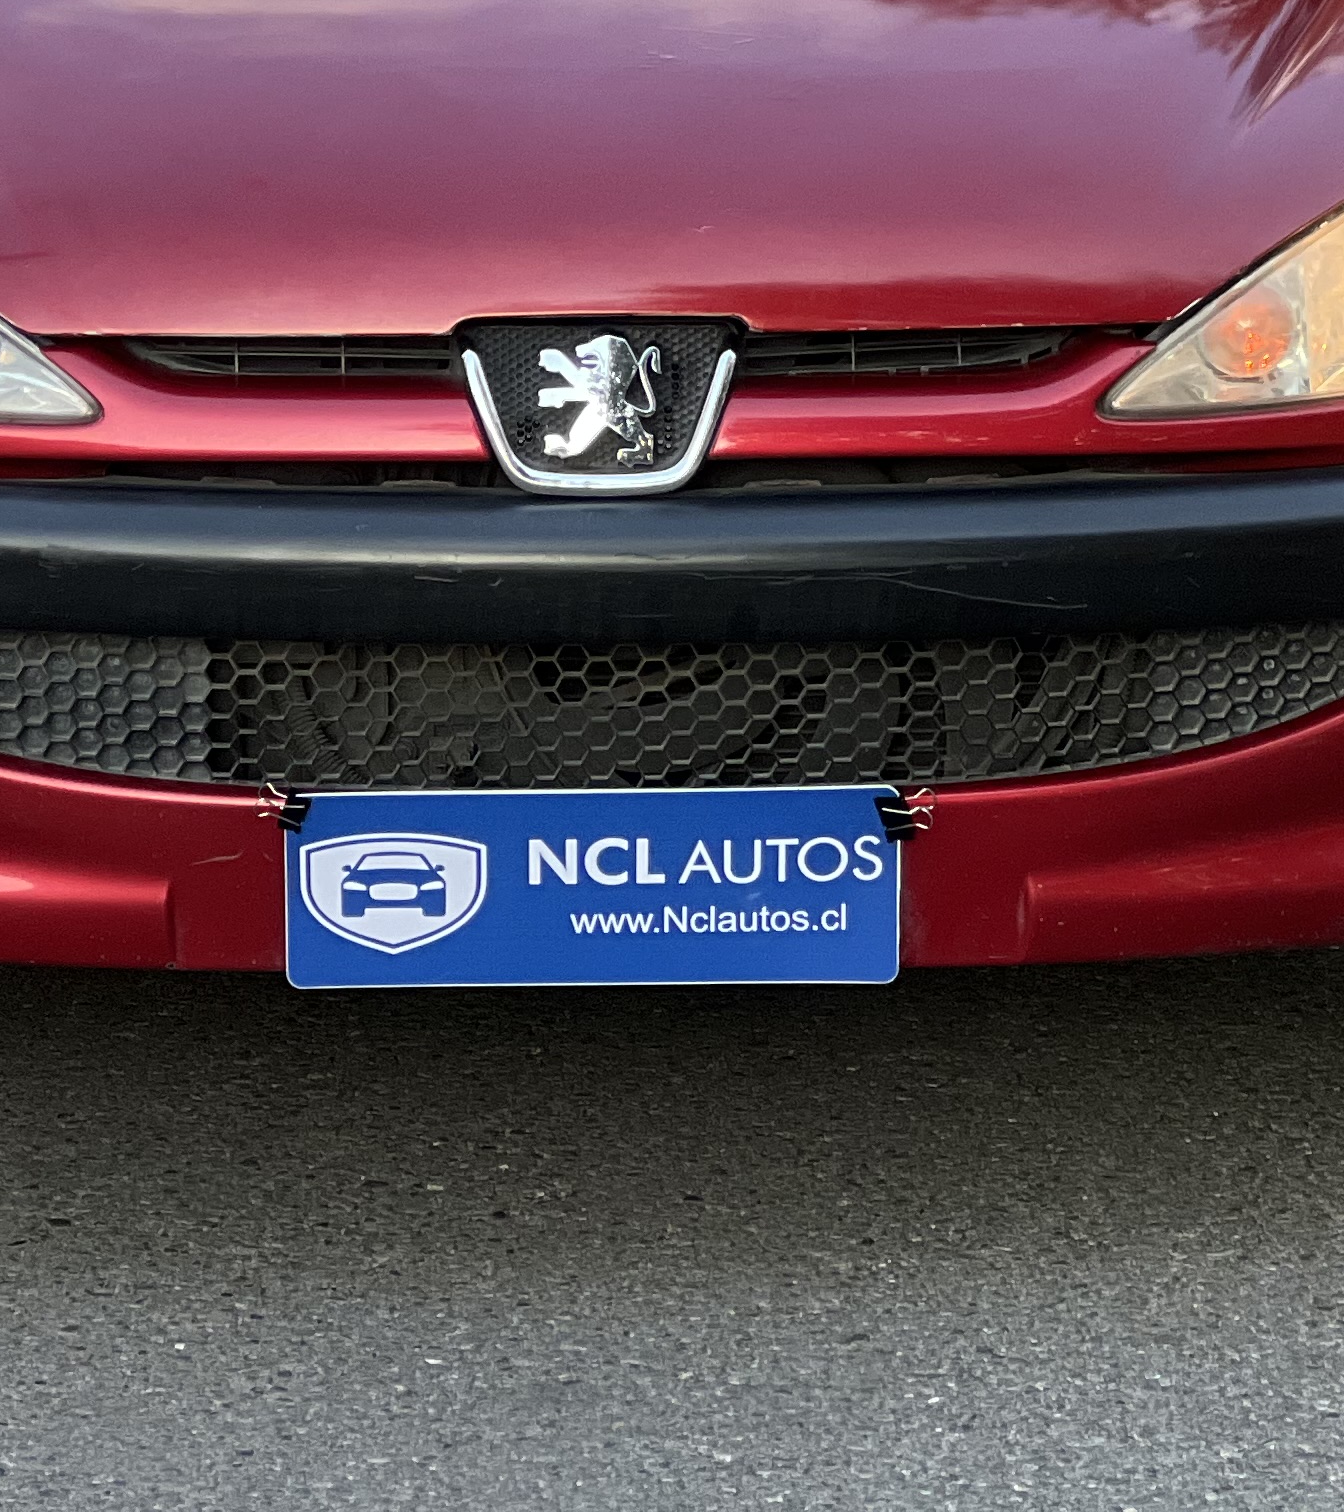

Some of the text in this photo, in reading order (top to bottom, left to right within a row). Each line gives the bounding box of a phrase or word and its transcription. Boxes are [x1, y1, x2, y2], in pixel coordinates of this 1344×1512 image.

[528, 835, 883, 886] NCL AUTOS
[569, 903, 847, 934] www.Nclautos.cl
